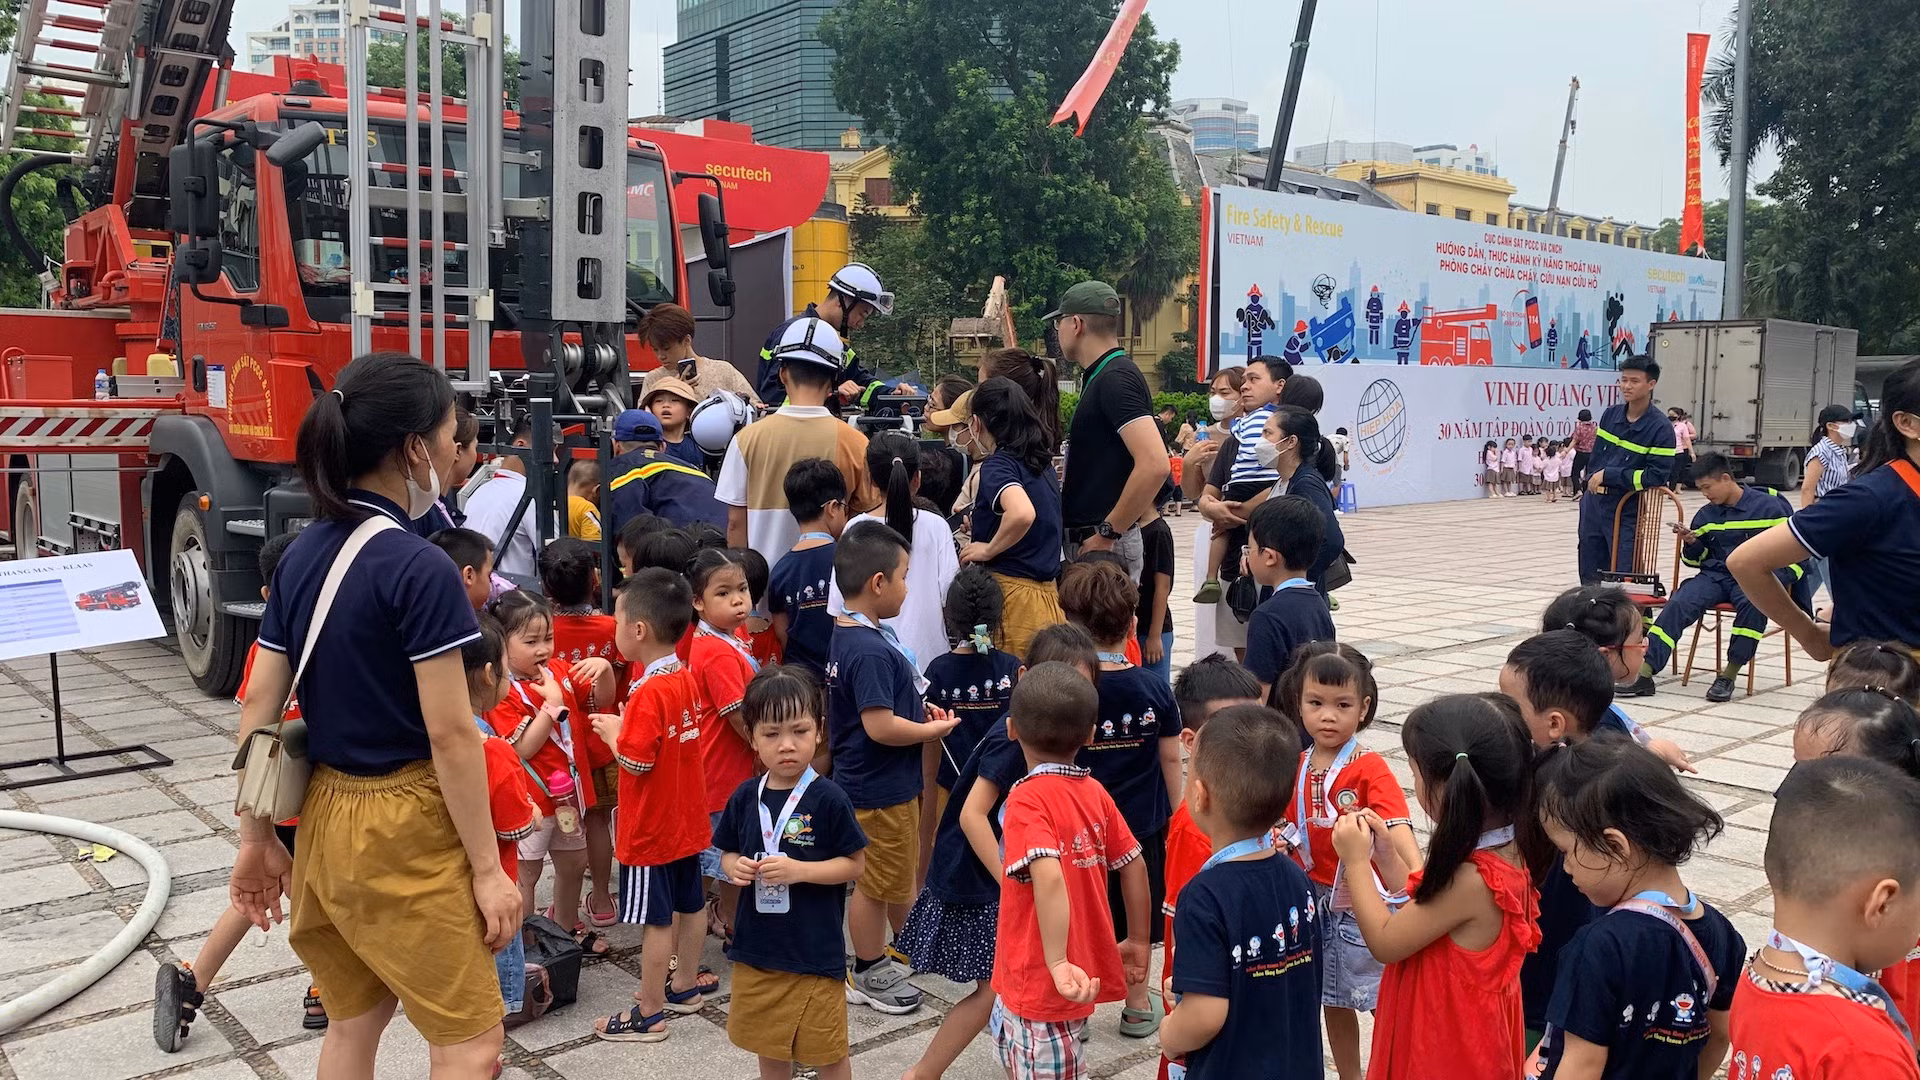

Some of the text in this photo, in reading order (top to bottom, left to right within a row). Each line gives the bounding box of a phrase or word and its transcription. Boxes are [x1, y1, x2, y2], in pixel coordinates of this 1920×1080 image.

[705, 163, 772, 183] secutech
[705, 179, 738, 190] VIENAM
[1227, 204, 1343, 237] Fire Safety & Rescue
[1228, 232, 1263, 247] VIETNAM
[1436, 240, 1465, 257] HƯỚNG
[1510, 251, 1530, 266] HÀNH
[1565, 260, 1586, 273] THOÁT
[1440, 258, 1468, 274] PHÒNG
[1470, 262, 1492, 277] CHÁY
[1588, 276, 1598, 291] HỘ
[1647, 268, 1686, 284] secutech
[1528, 316, 1538, 324] 114
[1484, 382, 1530, 406] VINH
[1534, 382, 1592, 412] QUANG
[1360, 418, 1381, 438] HIEP
[1438, 422, 1451, 440] 30
[1454, 418, 1482, 440] NĂM
[1486, 416, 1510, 442] TẬP
[1511, 417, 1544, 438] ĐOÀN
[1546, 416, 1554, 437] Ô
[1558, 416, 1572, 437] TÔ
[1474, 473, 1484, 487] 30
[62, 562, 94, 570] KLAAS
